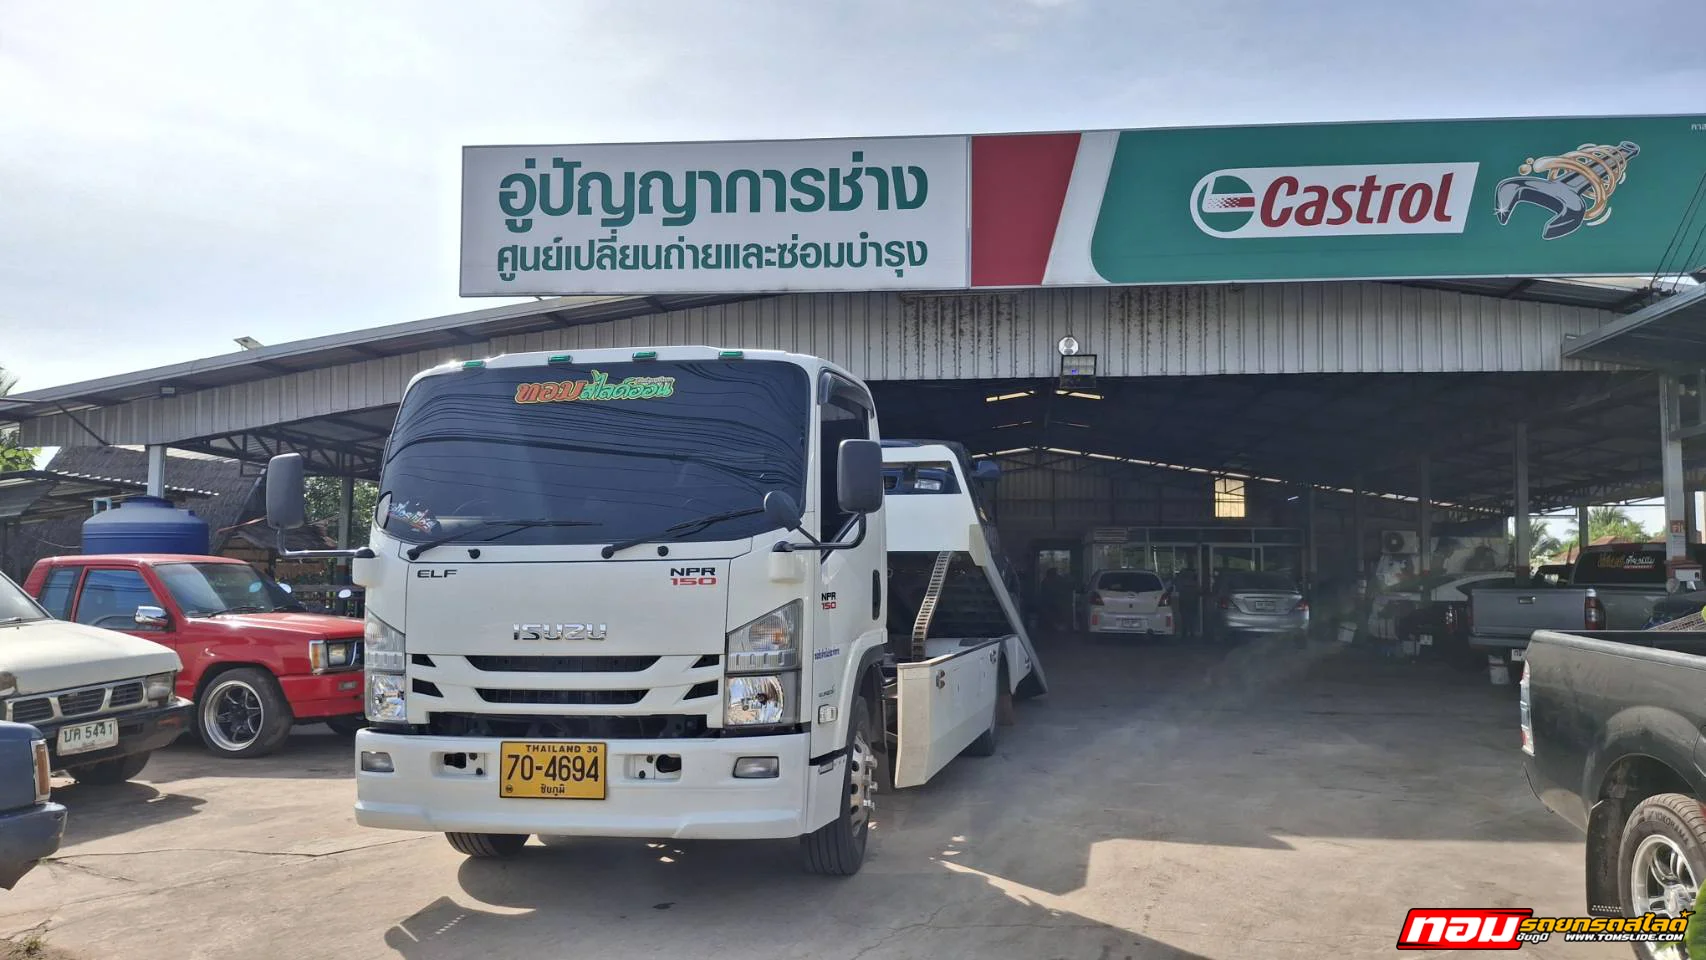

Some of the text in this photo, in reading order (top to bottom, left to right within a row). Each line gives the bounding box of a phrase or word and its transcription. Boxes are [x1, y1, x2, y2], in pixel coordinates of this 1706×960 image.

[498, 151, 929, 232] อู่ปัญญาการช่าง
[1260, 172, 1454, 228] Castrol
[498, 229, 928, 281] ศูนย์เปลี่ยนถ่ายและซ่อมบำรุง
[417, 569, 458, 578] ELF
[670, 567, 716, 577] NPR
[670, 577, 716, 586] 150
[821, 592, 837, 601] NPR
[821, 602, 837, 610] 150
[513, 623, 608, 641] ISUZU
[526, 744, 598, 753] THAILAND 30
[507, 754, 599, 782] 70-4694
